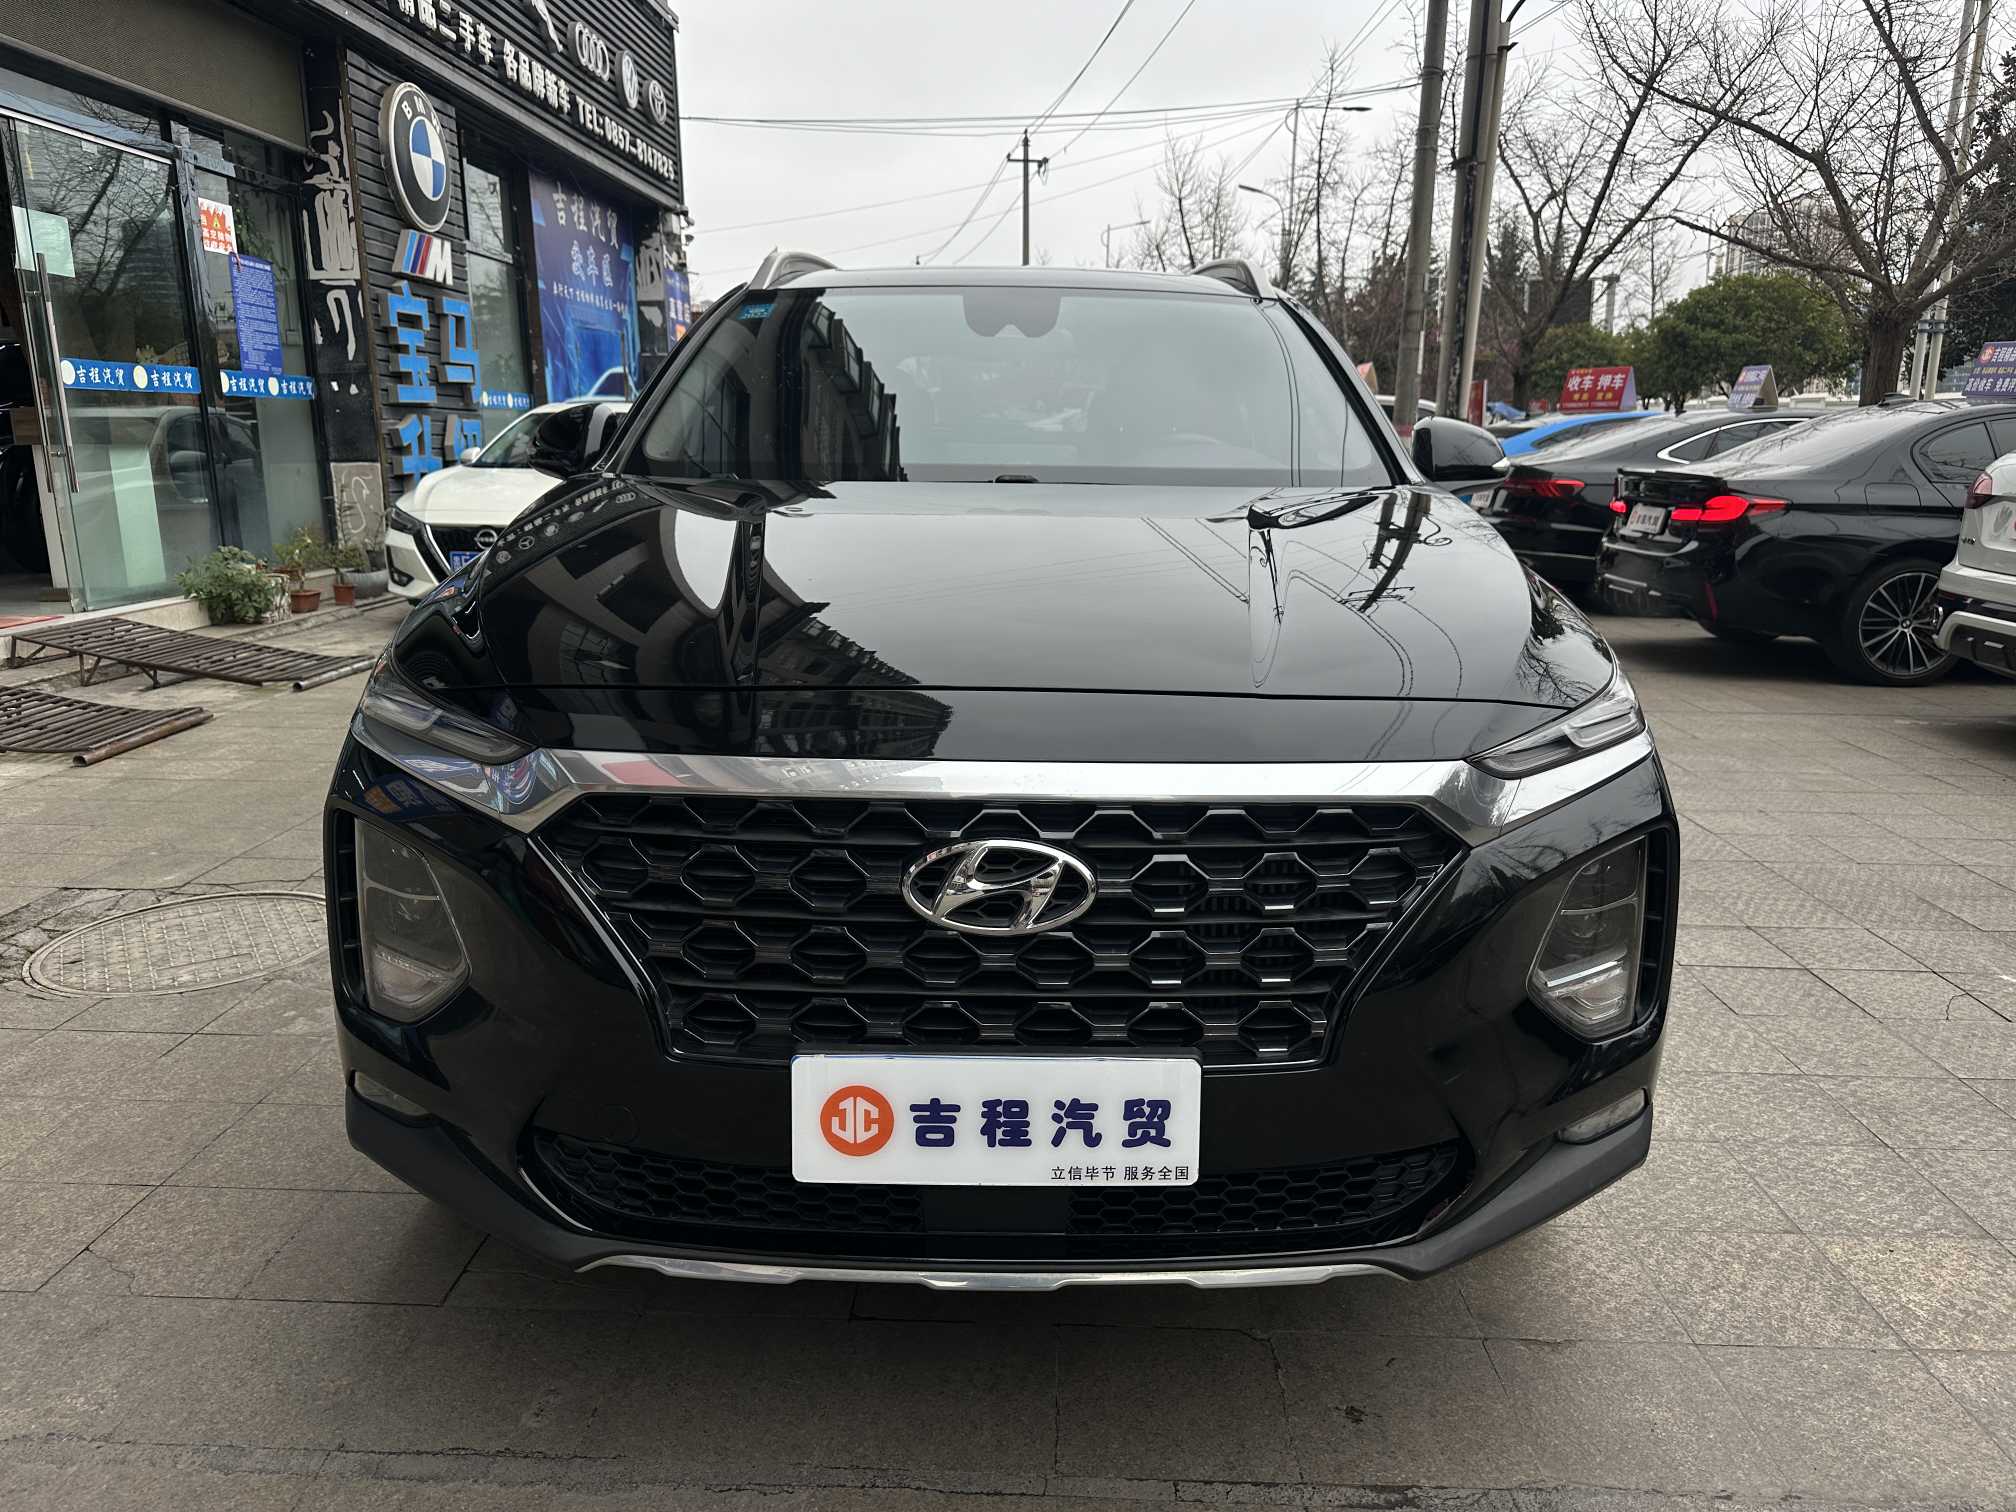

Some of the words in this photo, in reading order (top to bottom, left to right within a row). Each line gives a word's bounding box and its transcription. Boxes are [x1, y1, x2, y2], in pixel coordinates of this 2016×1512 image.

[552, 181, 619, 250] 吉程汽贸
[386, 279, 481, 404] 宝马
[76, 365, 125, 387] 吉程汽贸
[150, 370, 193, 389] 吉程汽贸
[228, 375, 265, 393] 吉程汽贸
[1567, 375, 1595, 392] 收车
[1596, 373, 1626, 391] 押车
[909, 1097, 1173, 1149] 吉程汽贸
[1051, 1165, 1117, 1182] 立信毕节
[1123, 1165, 1190, 1182] 服务全国
